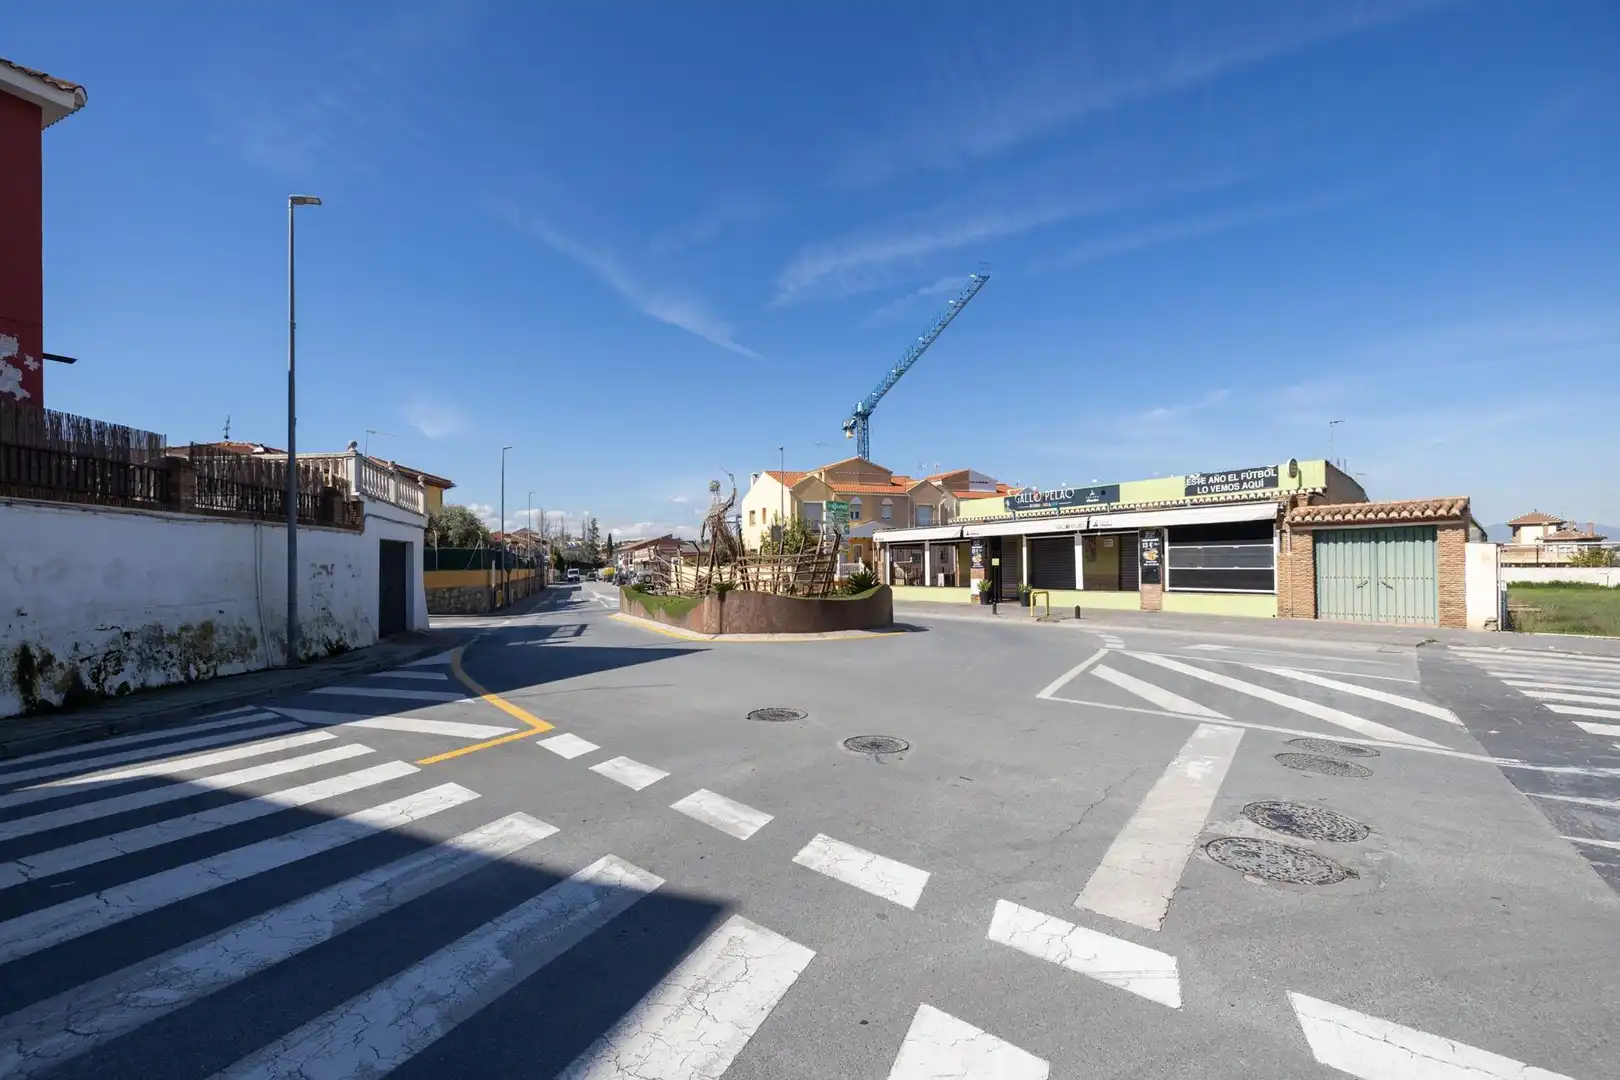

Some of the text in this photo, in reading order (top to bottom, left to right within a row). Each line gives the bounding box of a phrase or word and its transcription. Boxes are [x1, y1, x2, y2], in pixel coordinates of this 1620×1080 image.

[1186, 468, 1277, 486] ESTE AÑO EL FÚTBOL
[1197, 479, 1264, 494] LO VEMOS AQUÍ
[1015, 491, 1041, 504] GALLO
[1045, 488, 1075, 501] PELAO
